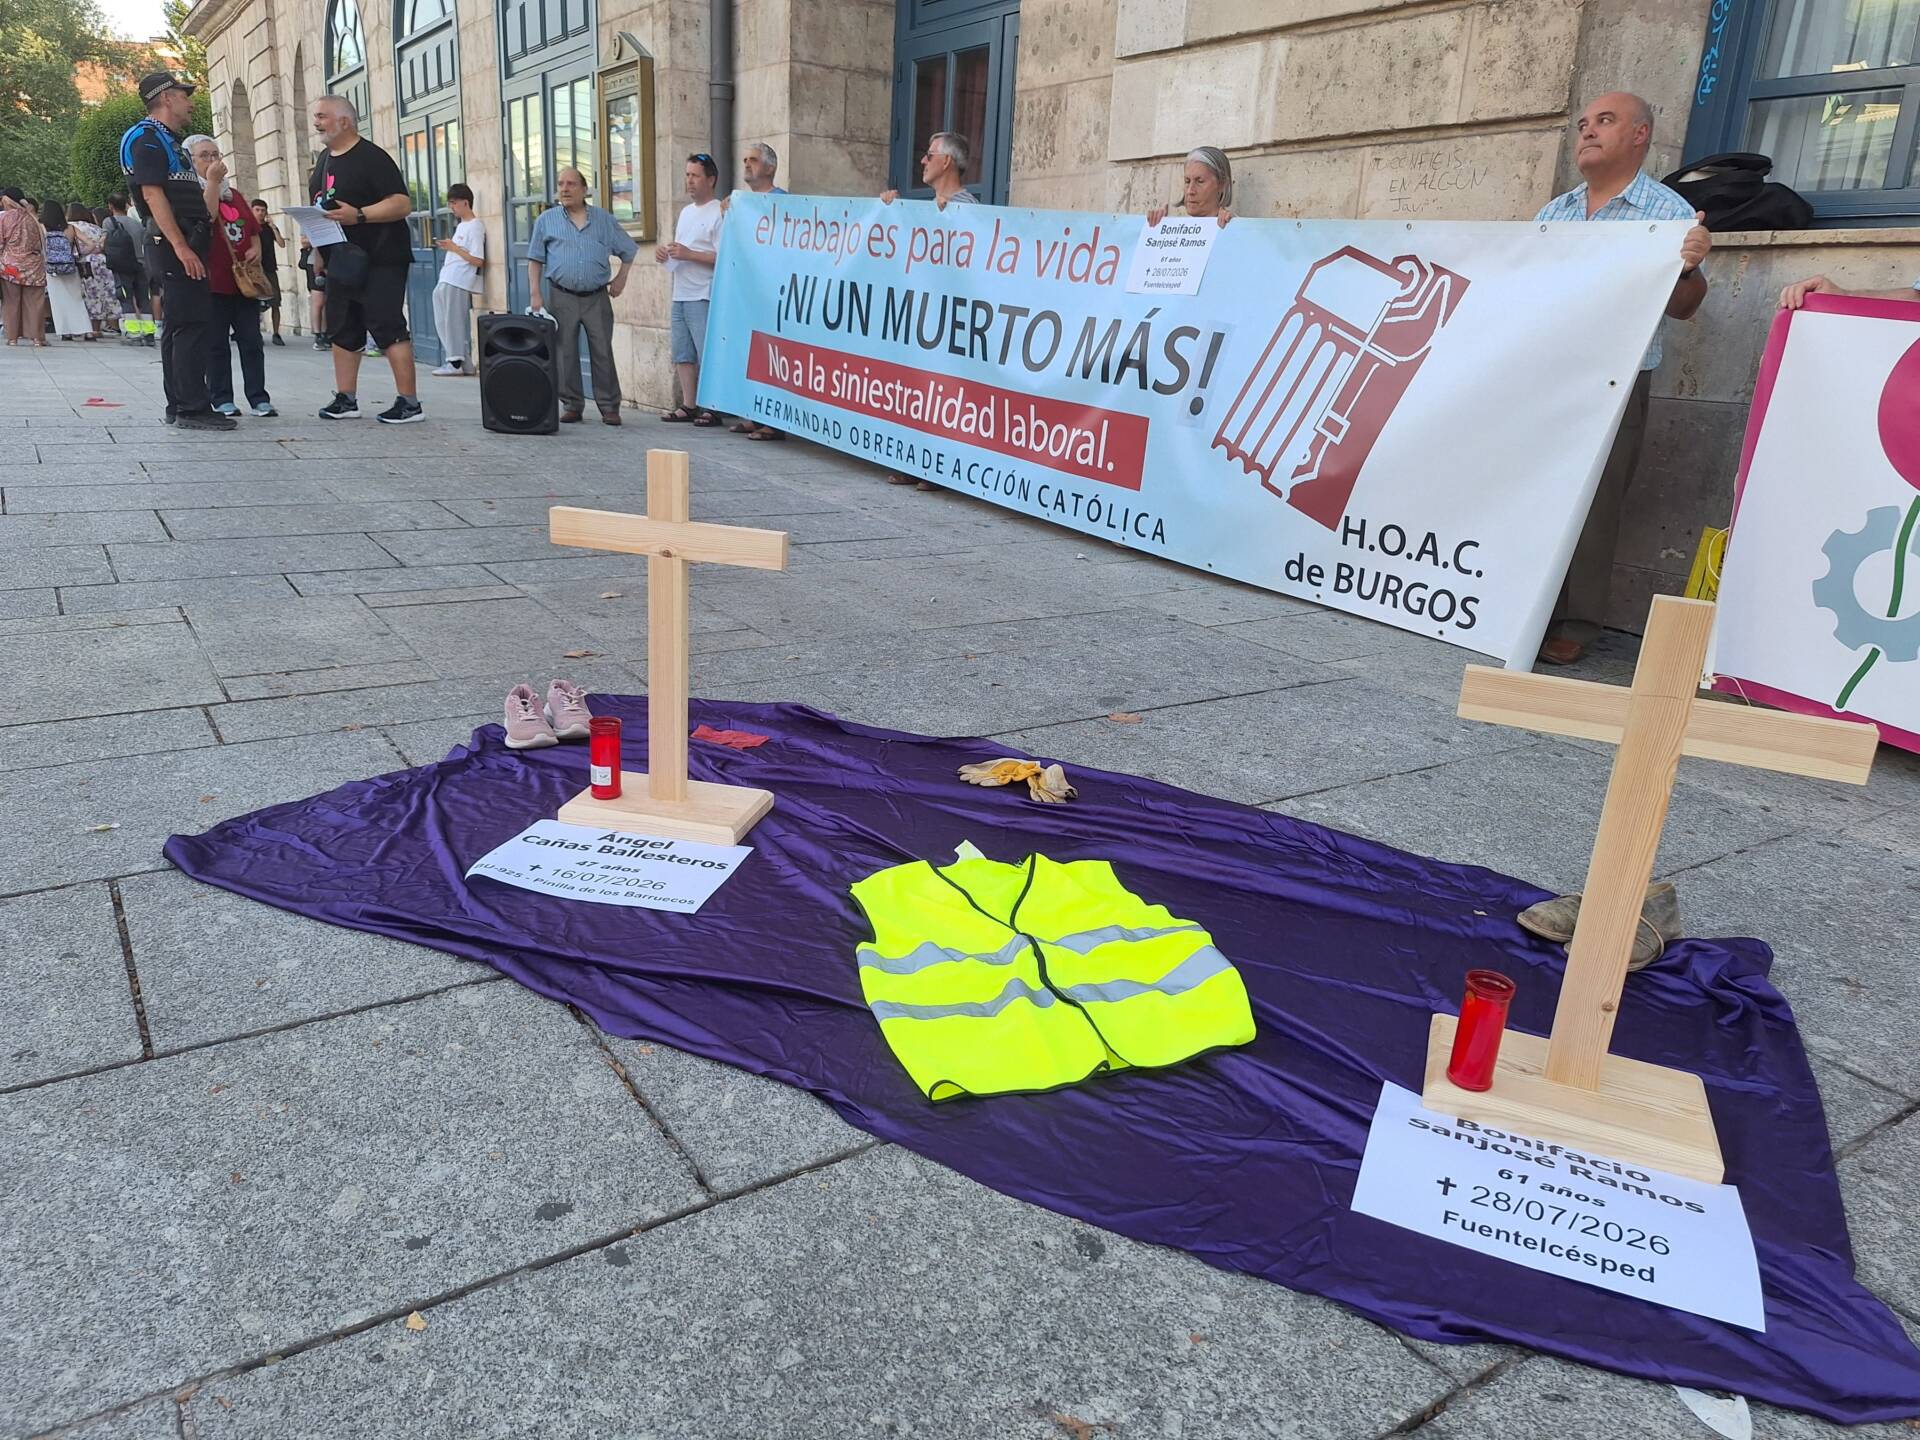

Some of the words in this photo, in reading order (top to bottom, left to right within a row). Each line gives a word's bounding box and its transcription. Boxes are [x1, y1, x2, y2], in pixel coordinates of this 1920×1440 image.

[756, 203, 776, 246] el
[783, 206, 861, 266] trabajo
[867, 223, 899, 259] es
[904, 223, 975, 274] para
[985, 218, 1021, 275] la
[1035, 225, 1121, 286] vida
[1145, 237, 1178, 249] Sanjosé
[1179, 238, 1206, 248] Ramos
[1160, 223, 1202, 235] Bonifacio
[776, 273, 818, 333] ¡NI
[822, 278, 873, 337] UN
[881, 287, 1063, 373] MUERTO
[1065, 307, 1226, 416] MÁS!
[767, 343, 790, 383] No
[793, 359, 803, 388] a
[808, 352, 826, 394] la
[831, 362, 995, 440] siniestralidad
[1004, 398, 1115, 472] laboral.
[754, 394, 842, 440] HERMANDAD
[849, 426, 916, 465] OBRERA
[921, 448, 945, 475] DE
[951, 457, 1031, 502] ACCIÓN
[1037, 484, 1166, 545] CATÓLICA
[1342, 515, 1483, 579] H.O.A.C.
[1284, 552, 1325, 587] de
[1333, 562, 1481, 630] BURGOS
[522, 835, 593, 851] Cañas
[597, 844, 729, 870] Ballesteros
[597, 831, 675, 850] Ángel
[600, 864, 641, 873] años
[533, 877, 575, 891] Pinilla
[578, 885, 596, 894] de
[599, 888, 620, 897] los
[623, 890, 696, 905] Barruecos
[552, 868, 667, 891] 16/07/2026
[1408, 1117, 1556, 1169] Sanjosé
[1569, 1164, 1706, 1214] Ramos
[1456, 1117, 1651, 1183] Bonifacio
[1469, 1185, 1671, 1256] 28/07/2026
[1497, 1168, 1529, 1185] 61
[1539, 1182, 1607, 1208] años
[1442, 1209, 1656, 1284] Fuentelcésped
